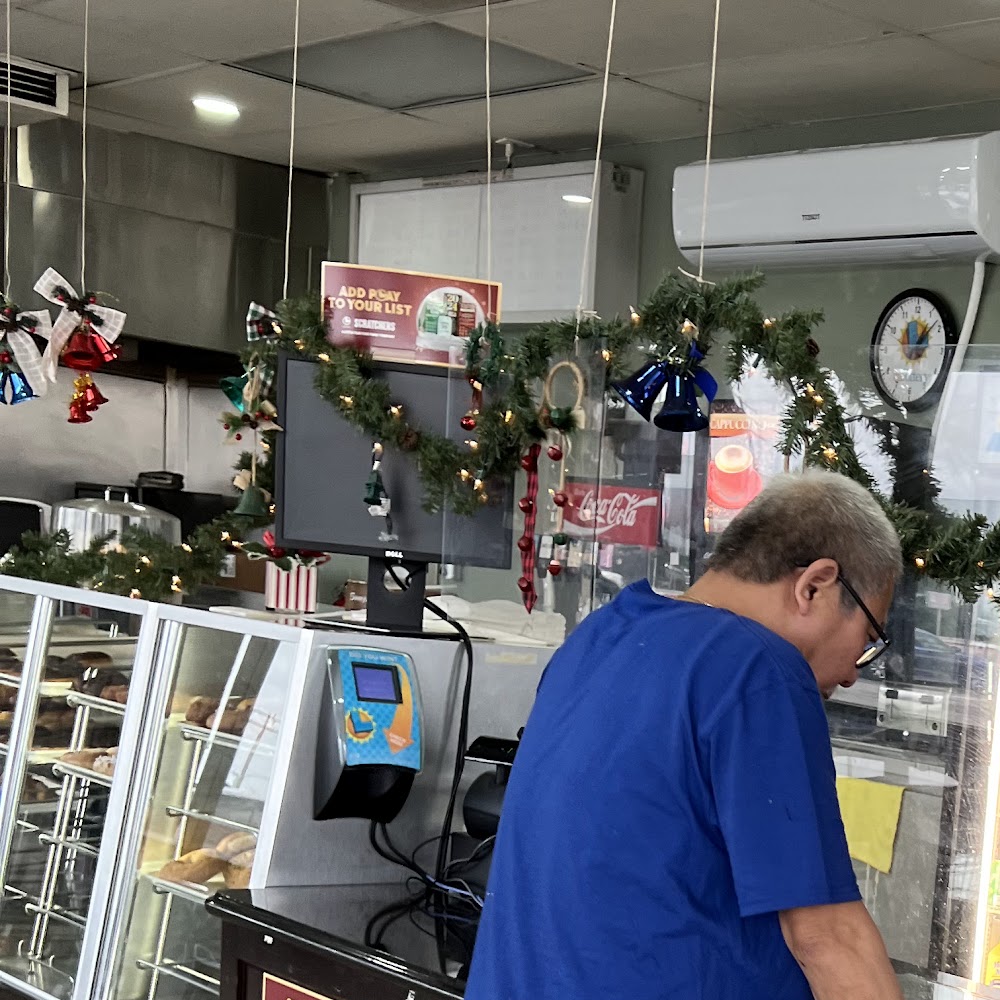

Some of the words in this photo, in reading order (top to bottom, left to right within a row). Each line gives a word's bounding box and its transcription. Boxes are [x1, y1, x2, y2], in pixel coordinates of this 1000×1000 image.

[339, 286, 366, 299] ADD
[328, 297, 344, 309] TO
[348, 299, 382, 313] YOUR
[385, 302, 412, 316] LIST
